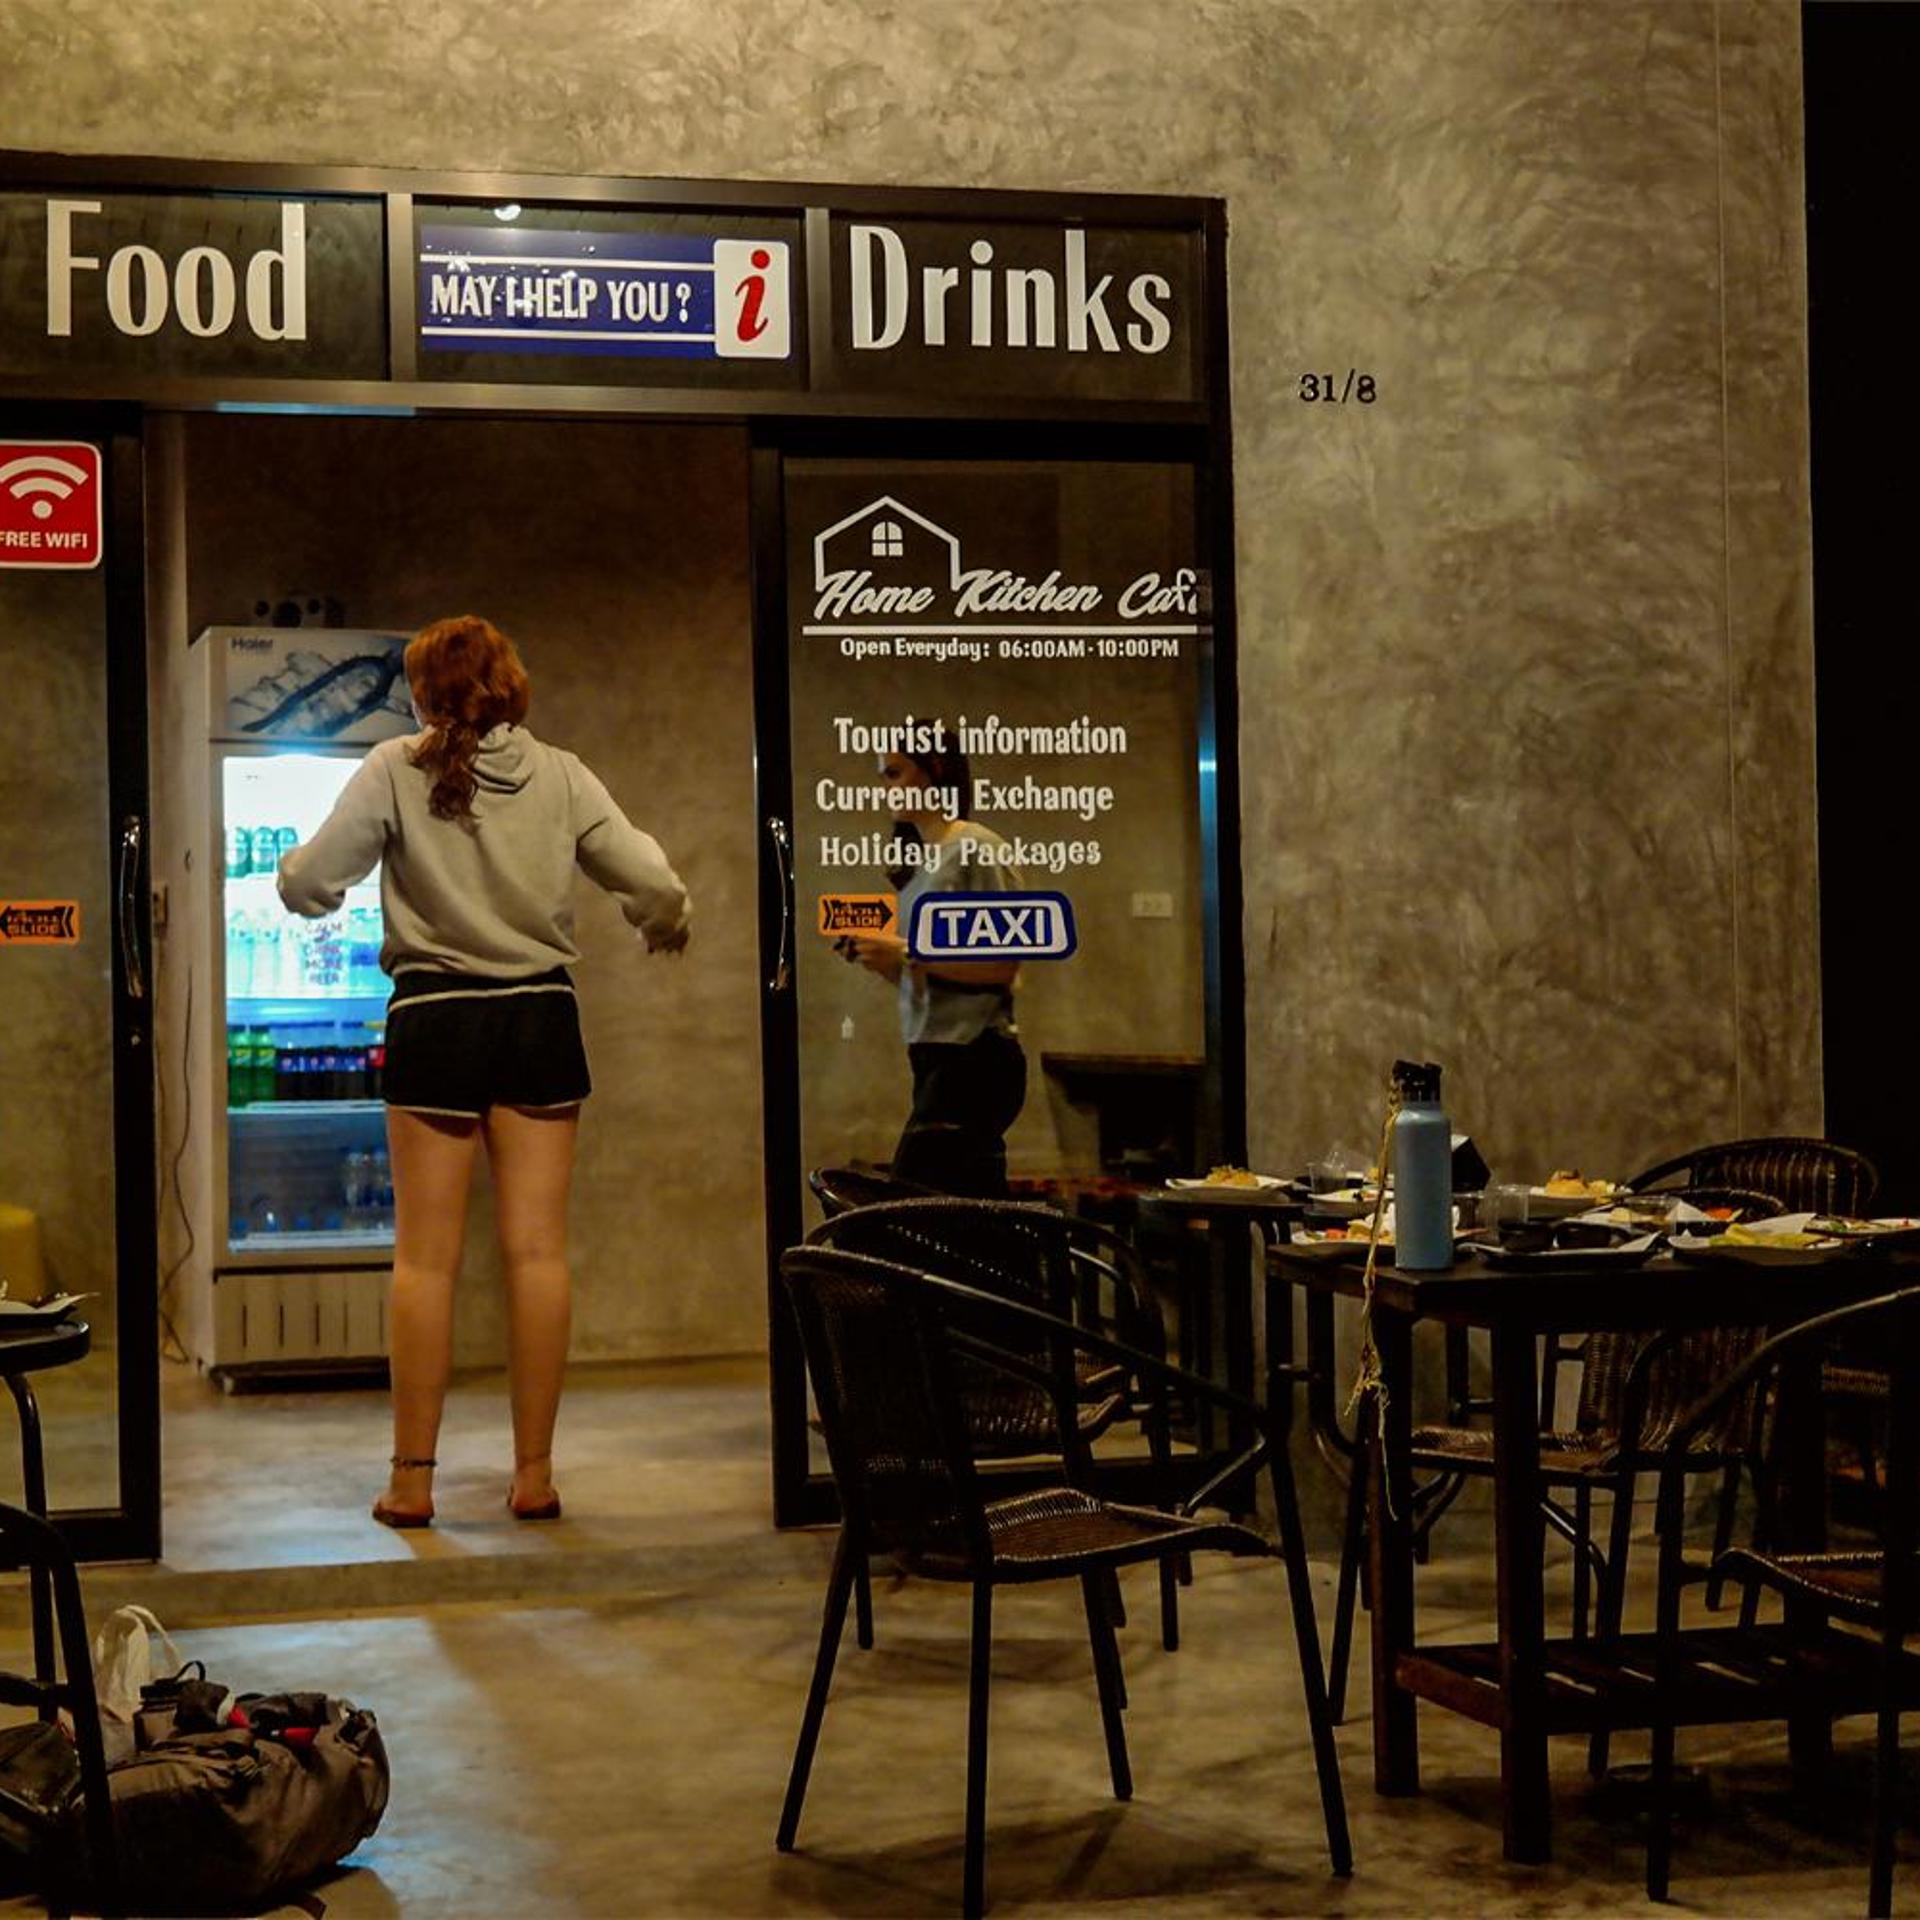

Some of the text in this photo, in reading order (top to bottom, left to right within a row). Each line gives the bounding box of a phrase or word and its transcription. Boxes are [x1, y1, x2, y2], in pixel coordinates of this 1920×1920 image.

[47, 200, 306, 340] Food
[850, 225, 1171, 354] Drinks
[431, 274, 497, 317] MAY
[521, 276, 597, 319] HELP
[1300, 368, 1376, 404] 31/8
[0, 530, 88, 549] FREE WIFI
[813, 570, 935, 619] Home
[953, 570, 1102, 618] Kitchen
[231, 637, 273, 649] Haier
[840, 638, 891, 659] Open
[834, 715, 1127, 754] Tourist information
[816, 777, 1114, 821] Currency Exchange
[820, 832, 1101, 874] Holiday Packages
[938, 908, 1046, 947] TAXI
